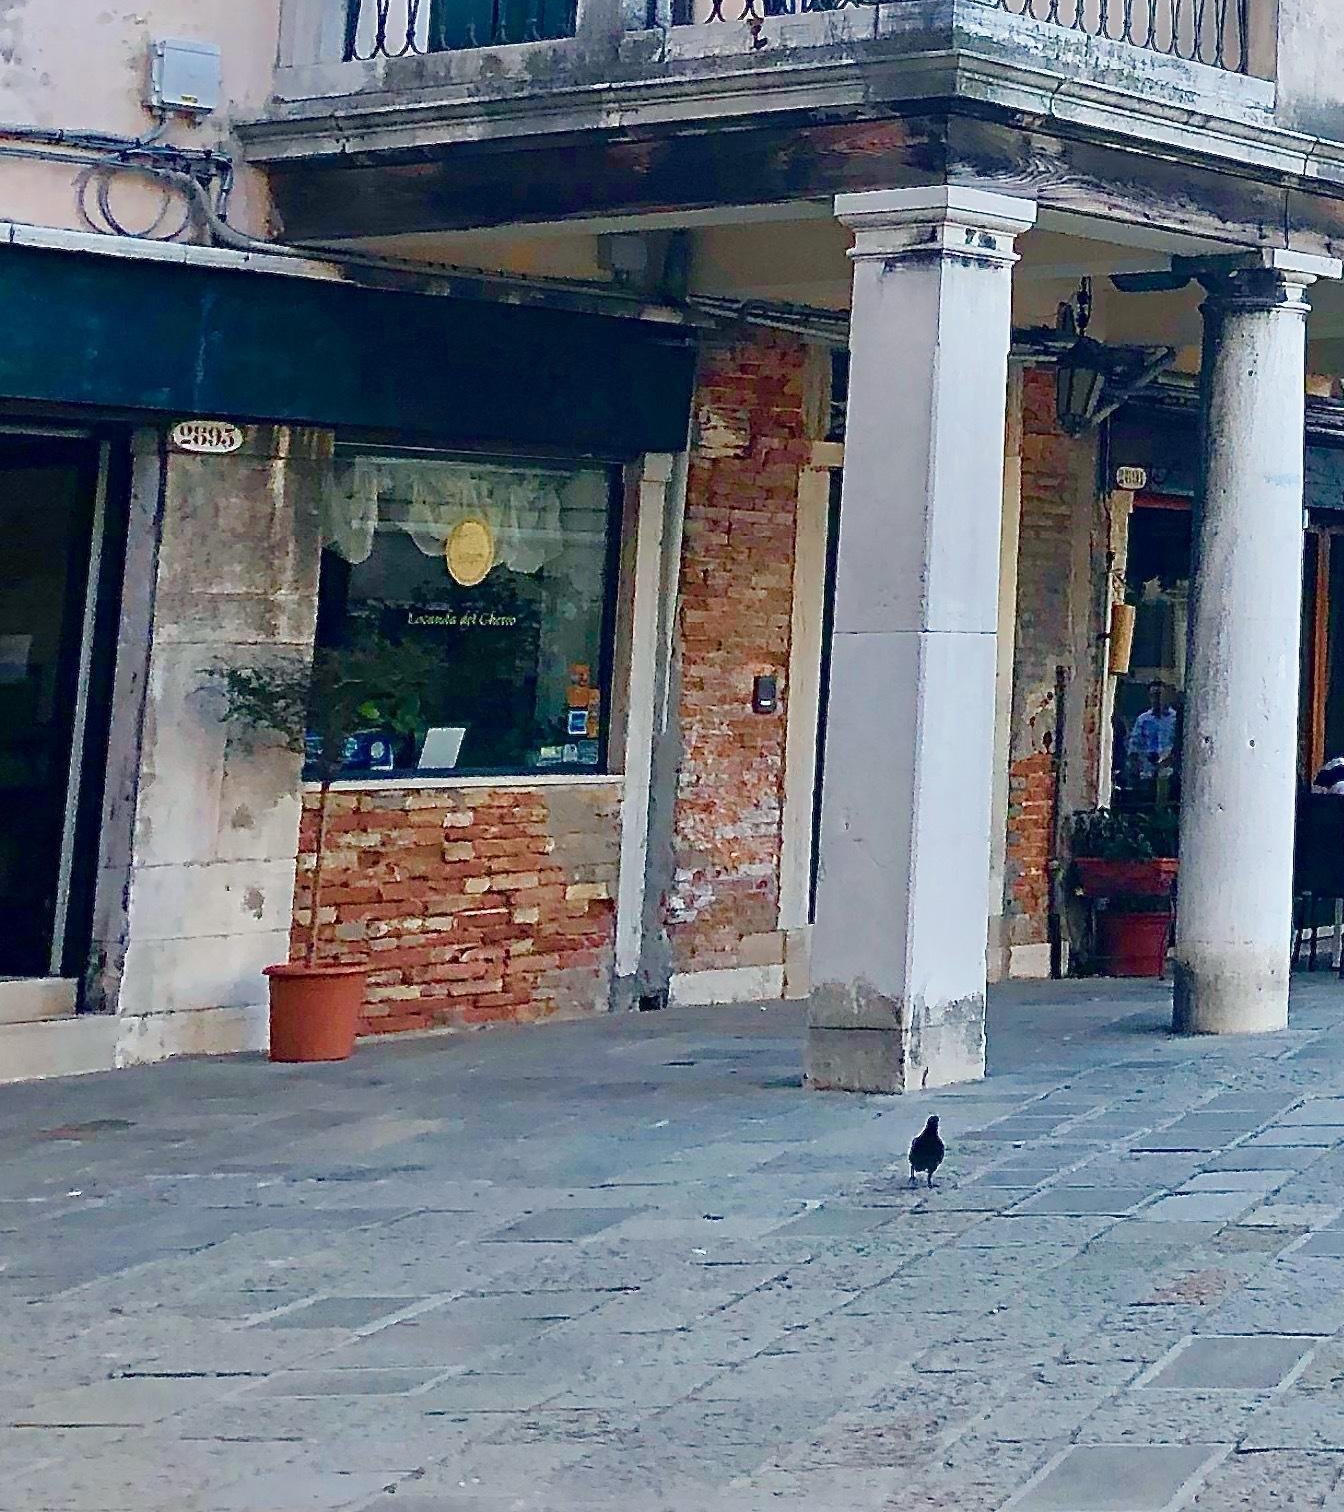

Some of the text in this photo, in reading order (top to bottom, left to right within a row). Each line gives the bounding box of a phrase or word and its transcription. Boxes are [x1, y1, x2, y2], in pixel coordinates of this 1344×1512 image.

[407, 609, 517, 627] Locanda del Ghetto
